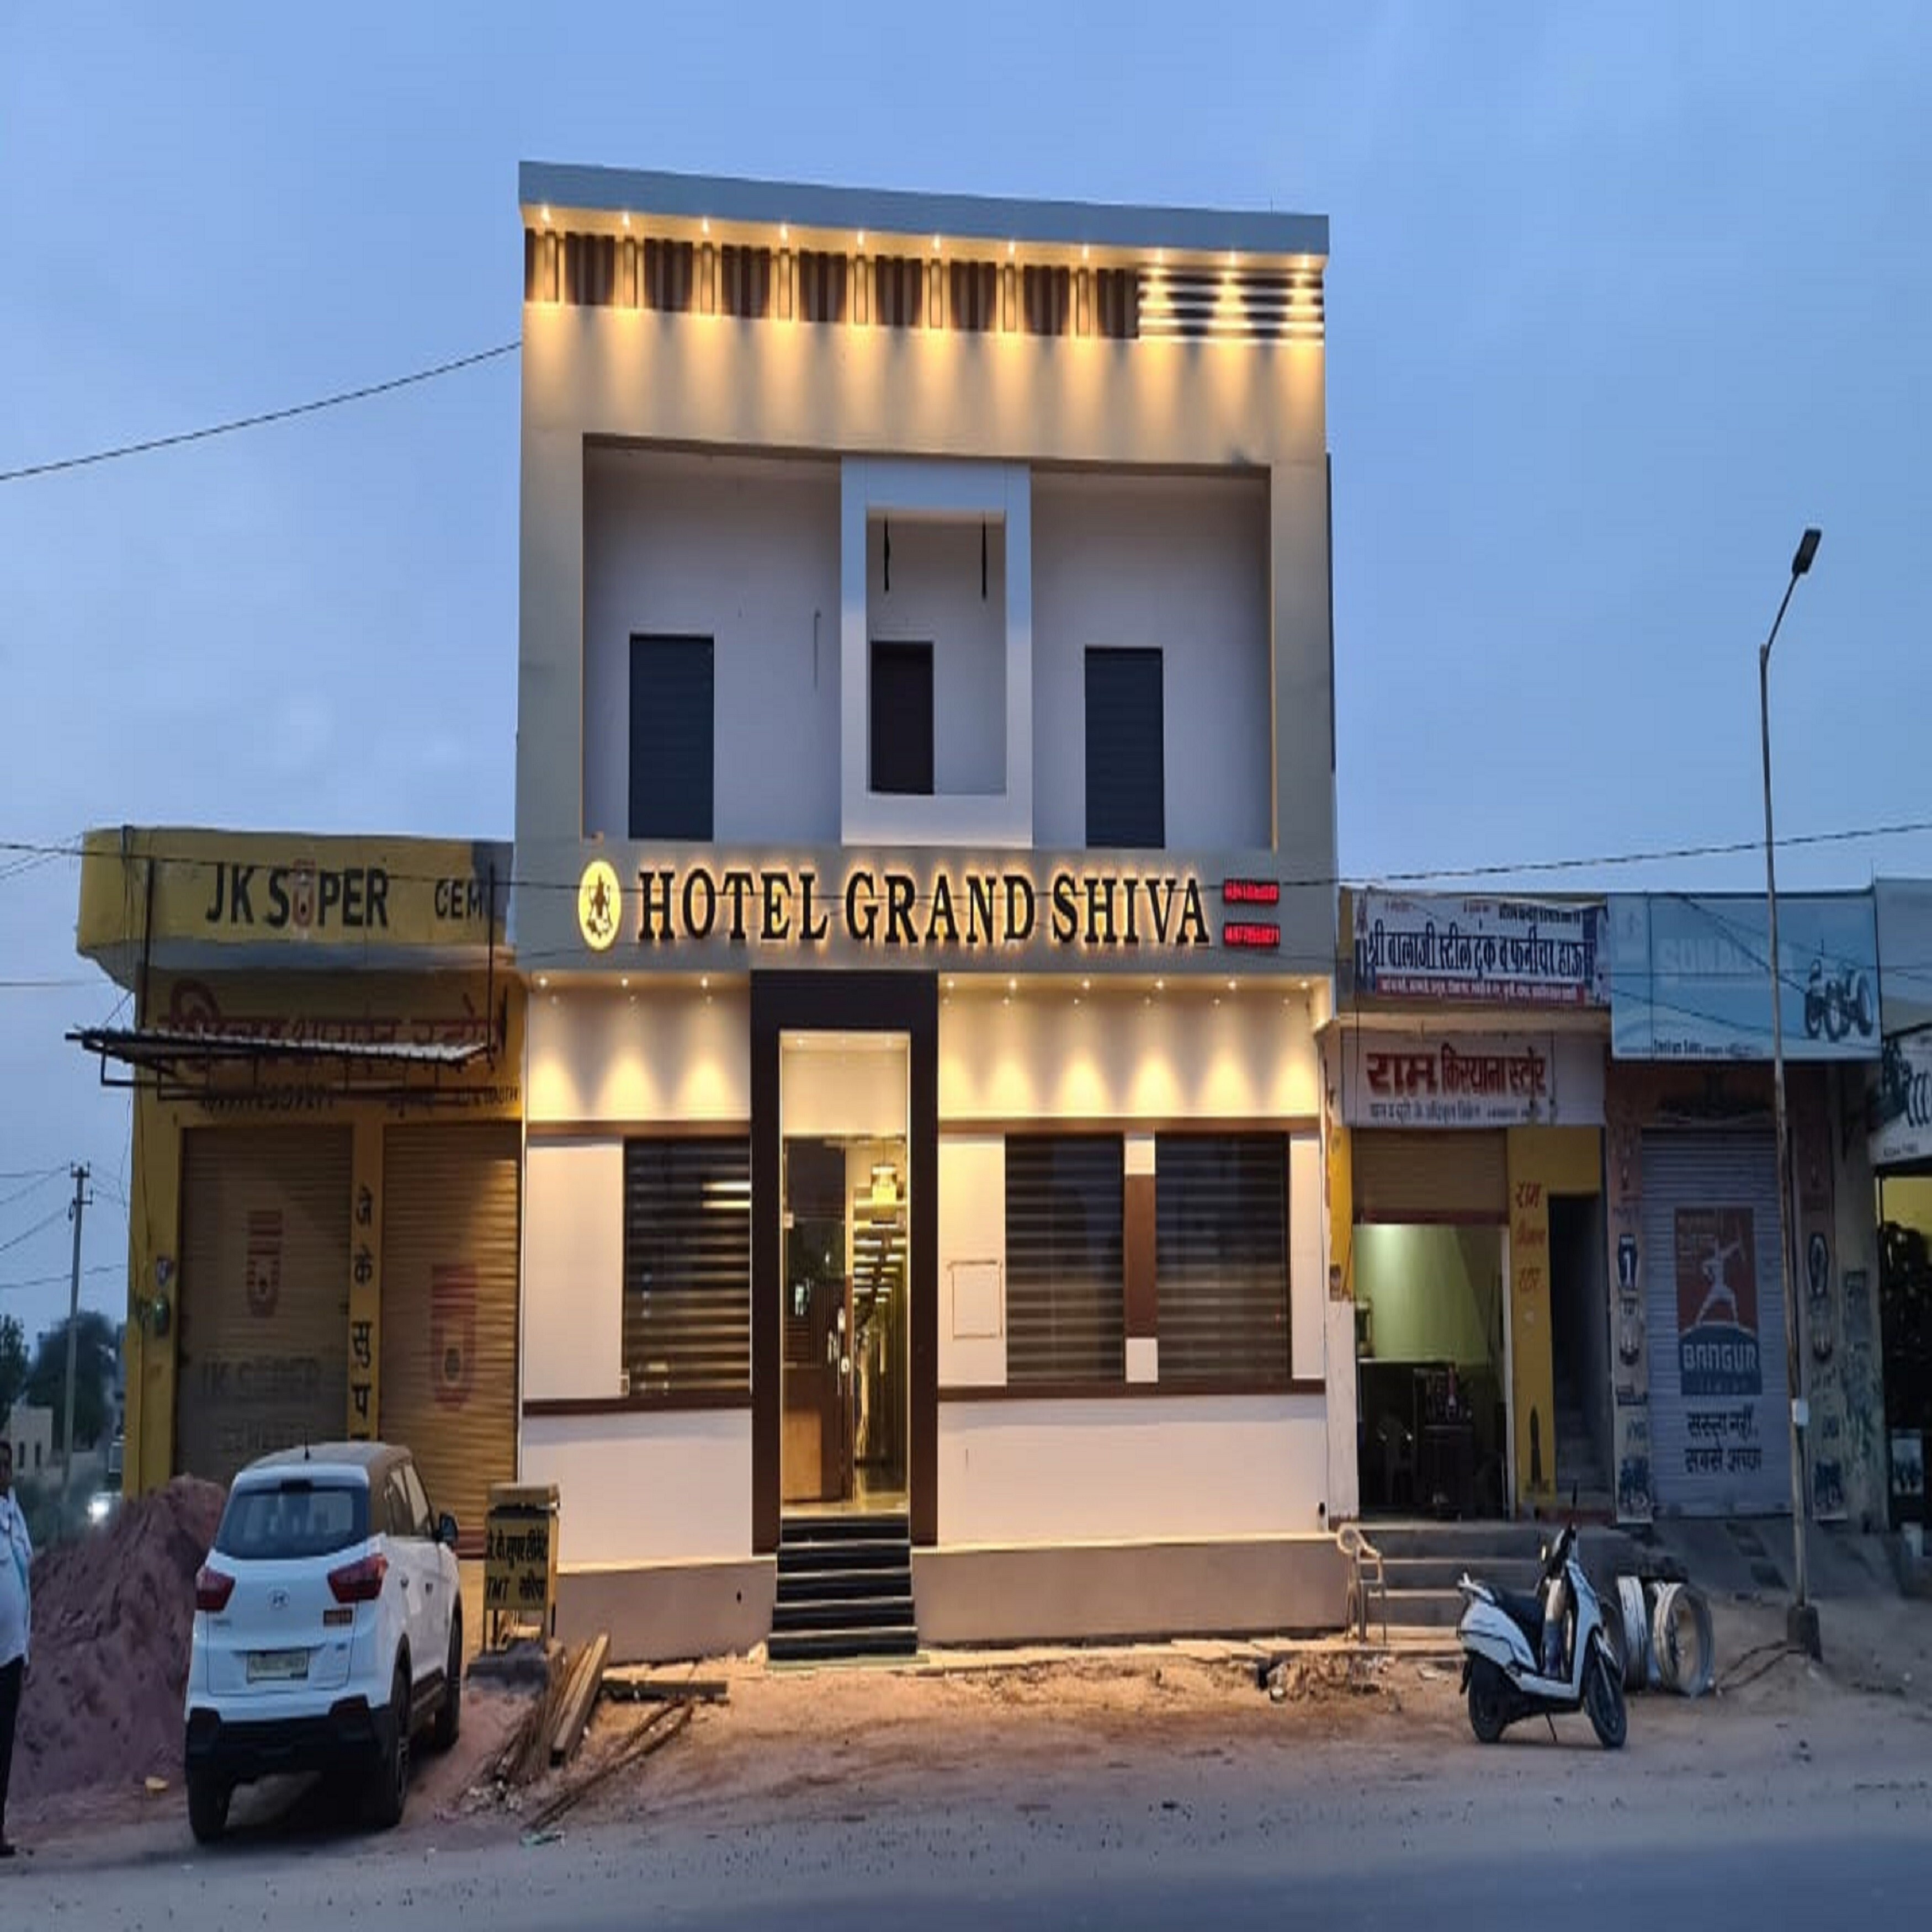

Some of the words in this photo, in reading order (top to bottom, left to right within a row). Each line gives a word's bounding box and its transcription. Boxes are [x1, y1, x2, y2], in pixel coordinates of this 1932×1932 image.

[205, 862, 255, 924] JK
[267, 862, 389, 928] SUPER
[639, 868, 828, 940] HOTEL
[846, 872, 1035, 943] GRAND
[1052, 874, 1209, 943] SHIVA
[1368, 919, 1384, 967] श्री
[1439, 921, 1471, 970] स्टील
[1366, 1052, 1437, 1096] राम
[1683, 1341, 1758, 1373] BANGUR
